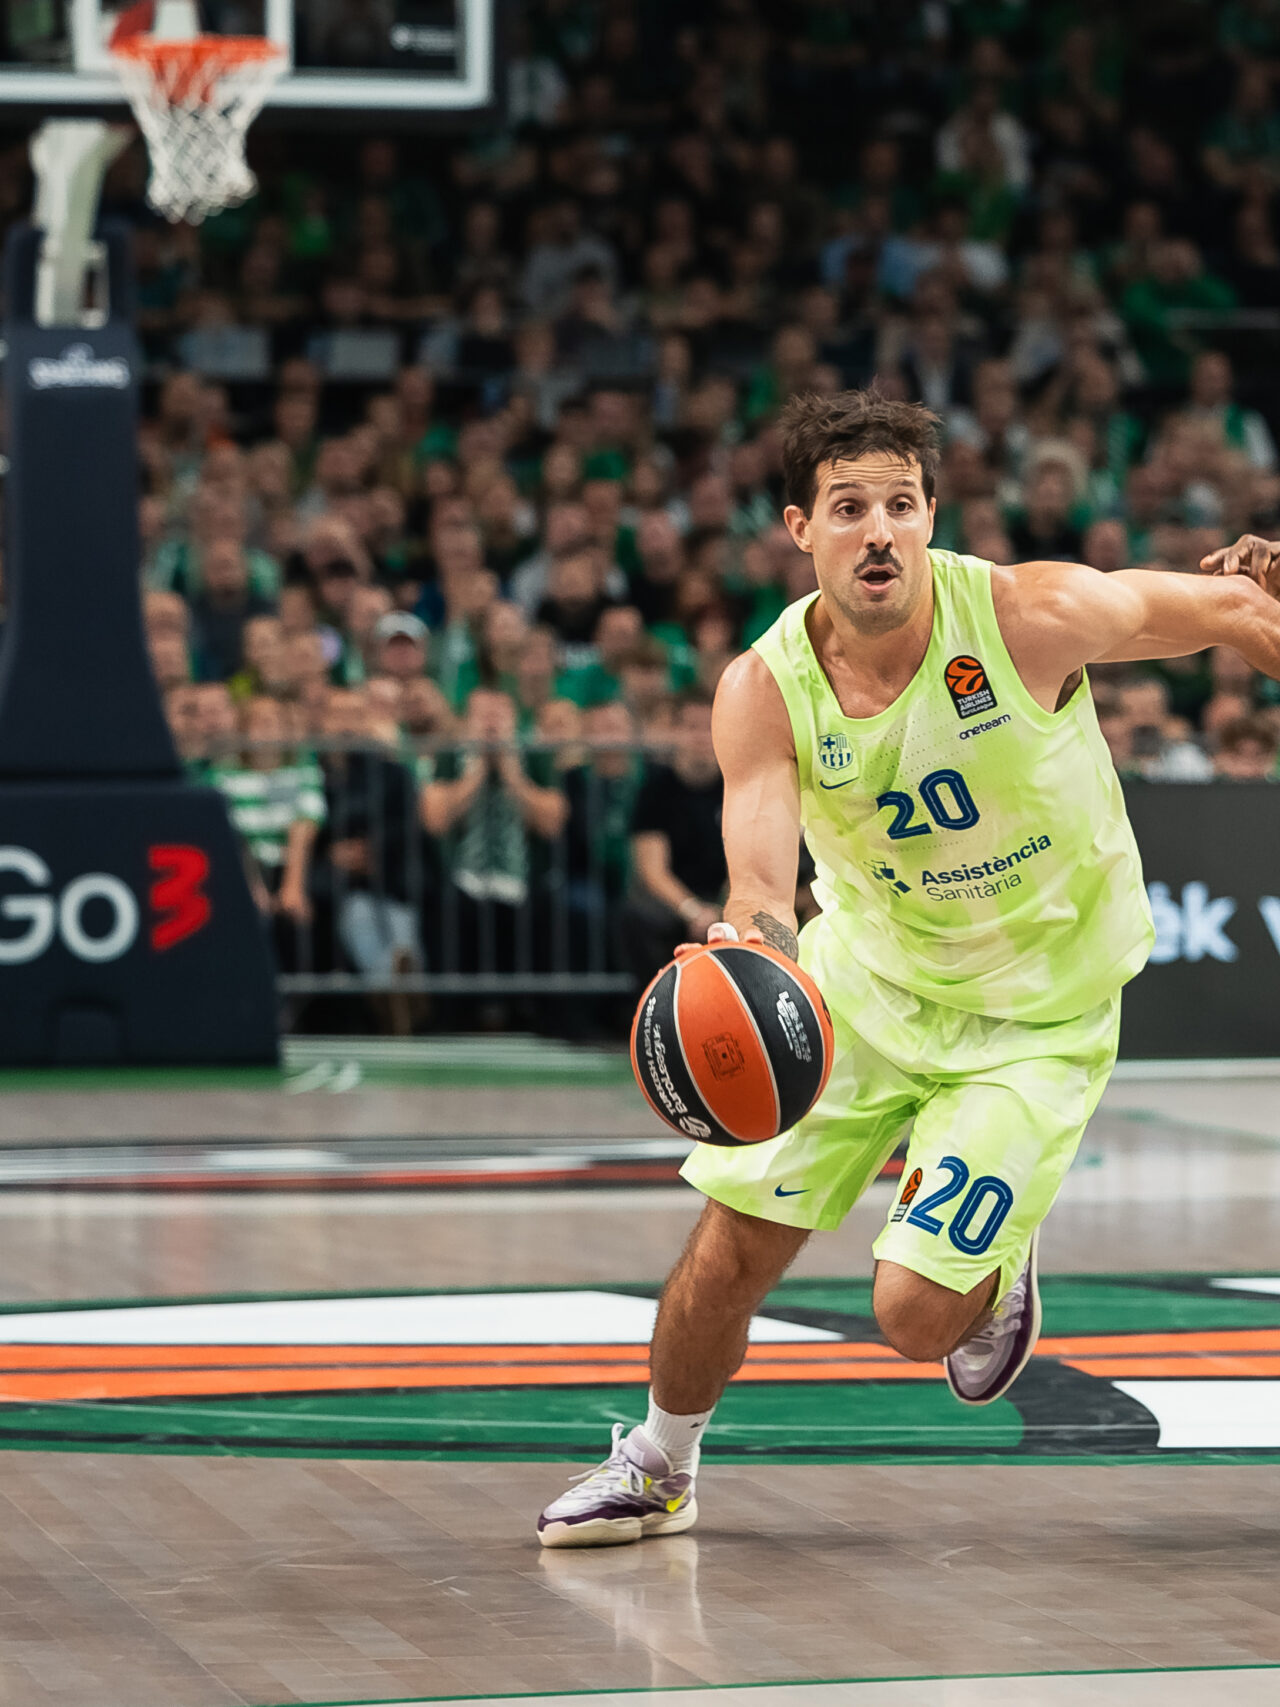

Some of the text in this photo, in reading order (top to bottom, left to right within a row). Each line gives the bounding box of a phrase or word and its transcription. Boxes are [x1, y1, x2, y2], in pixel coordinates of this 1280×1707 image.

[957, 689, 990, 704] TURKISH
[960, 695, 992, 711] AIRLINES
[959, 714, 1011, 740] oneteam
[876, 769, 980, 840] 20
[921, 834, 1052, 886] Assistència
[926, 873, 1022, 901] Sanitària
[906, 1156, 1014, 1256] 20
